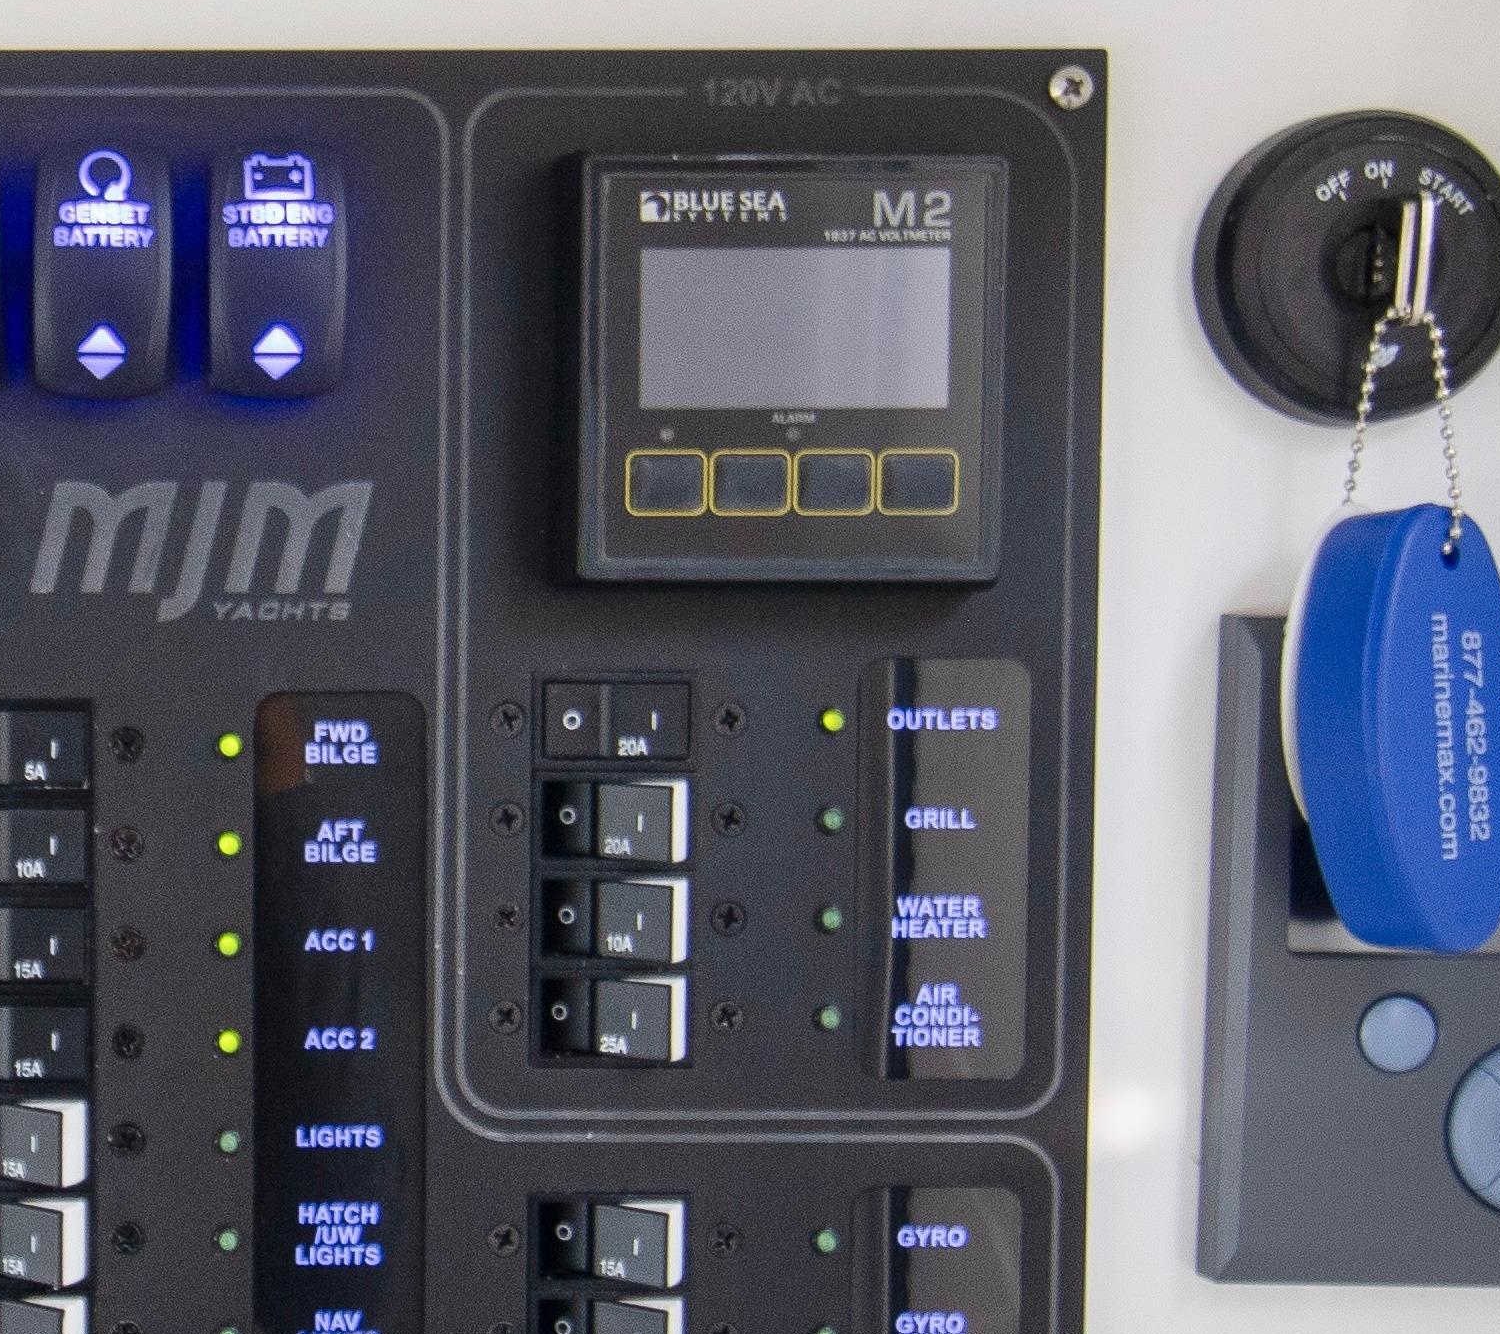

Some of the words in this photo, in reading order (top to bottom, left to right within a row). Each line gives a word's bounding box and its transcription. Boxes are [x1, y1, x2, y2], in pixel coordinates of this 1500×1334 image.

[705, 79, 782, 106] 120V
[790, 79, 842, 106] AC
[1365, 160, 1396, 179] ON
[1316, 169, 1350, 201] OFF
[1418, 169, 1474, 215] START
[673, 191, 734, 211] BLUE
[739, 191, 785, 210] SEA
[873, 190, 952, 228] M2
[58, 201, 150, 225] GENSET
[286, 202, 334, 225] ENG
[673, 212, 788, 222] SYSTEMS
[54, 225, 154, 247] BATTERY
[228, 226, 330, 247] BATTERY
[213, 601, 351, 621] YACHTS
[887, 710, 997, 730] OUTLETS
[314, 722, 368, 743] FWD
[1432, 613, 1460, 861] marinemax.com
[305, 744, 378, 765] BILGE
[617, 738, 648, 756] 20A
[24, 763, 47, 781] 5A
[905, 809, 976, 829] GRILL
[317, 822, 364, 842] AFT
[304, 842, 377, 863] BILGE
[16, 861, 44, 878] 10A
[897, 897, 981, 918] WATER
[891, 918, 986, 939] HEATER
[304, 931, 358, 951] ACC
[363, 931, 375, 952] 1
[606, 935, 632, 952] 10A
[15, 961, 42, 979] 15A
[916, 985, 958, 1005] AIR
[894, 1006, 980, 1026] CONDI-
[304, 1031, 355, 1050] ACC
[359, 1030, 377, 1050] 2
[892, 1027, 981, 1047] TIONER
[16, 1060, 42, 1078] 15A
[296, 1127, 382, 1148] LIGHTS
[2, 1160, 24, 1178] 15A
[298, 1205, 379, 1225] HATCH
[315, 1226, 361, 1245] /UW
[898, 1227, 967, 1247] GYRO
[295, 1245, 381, 1266] LIGHTS
[2, 1259, 24, 1276] 15A
[600, 1260, 624, 1278] 15A
[315, 1311, 362, 1331] NAV
[895, 1314, 965, 1334] GYRO
